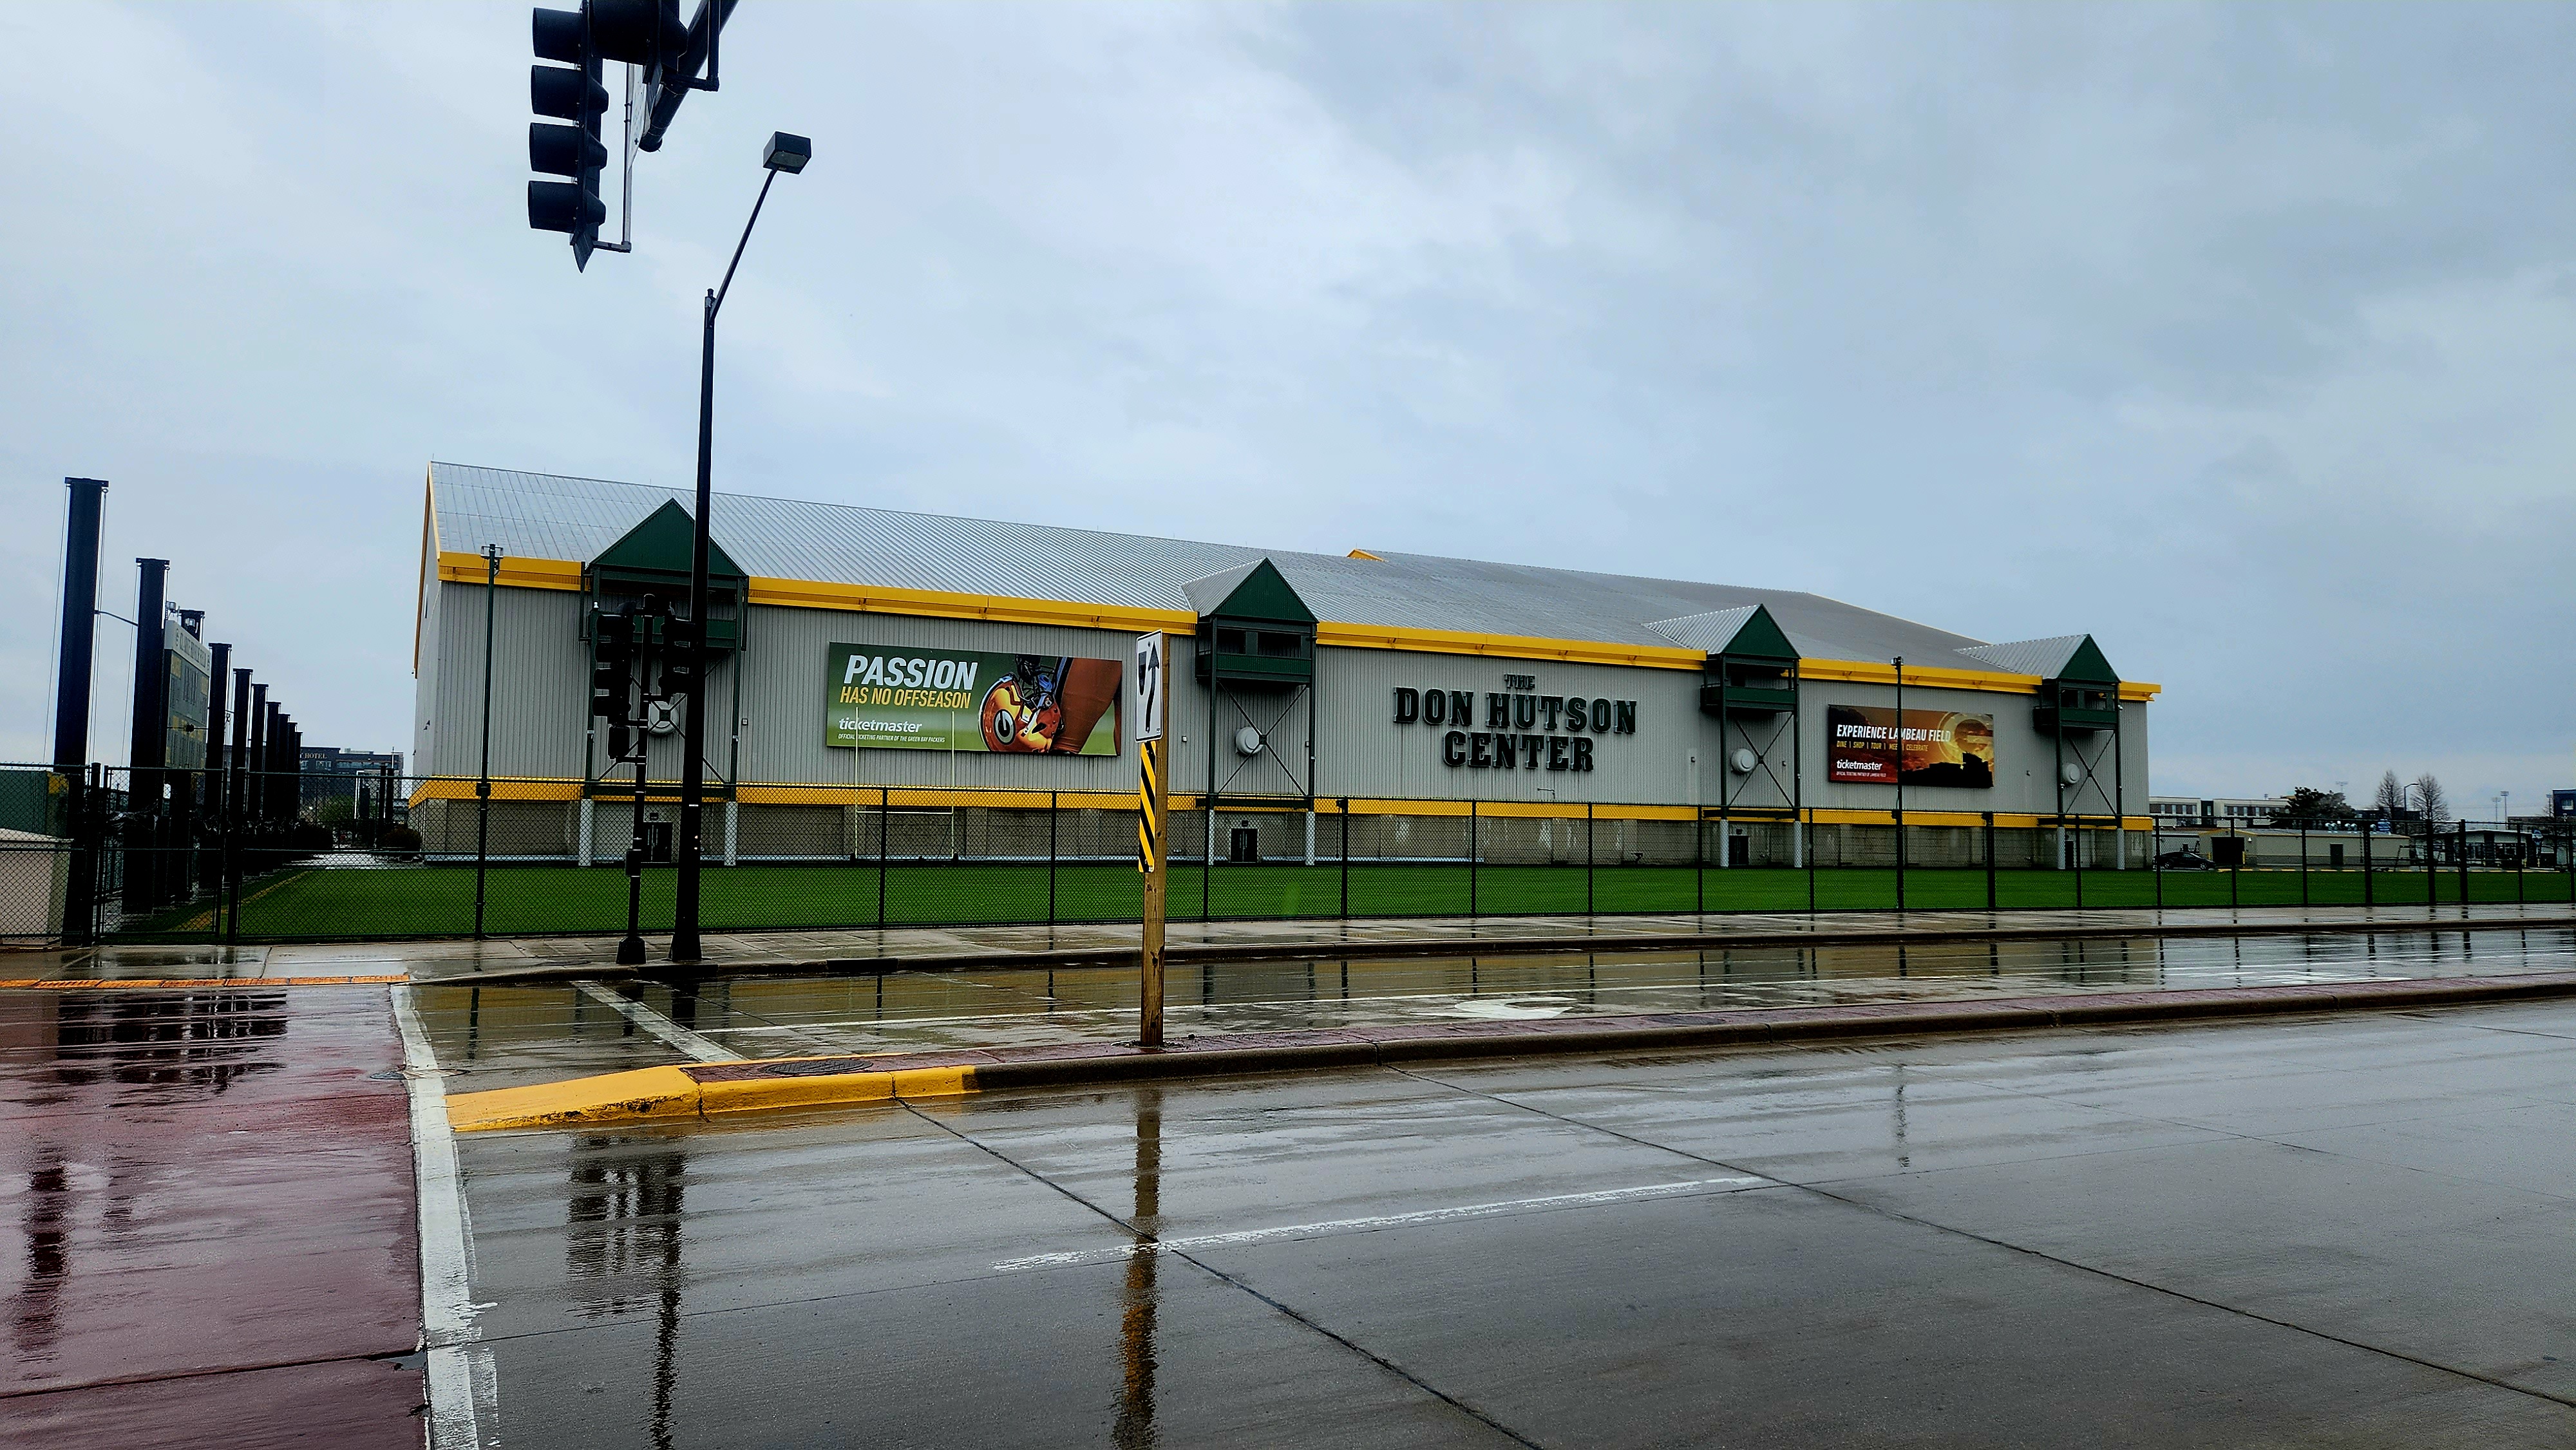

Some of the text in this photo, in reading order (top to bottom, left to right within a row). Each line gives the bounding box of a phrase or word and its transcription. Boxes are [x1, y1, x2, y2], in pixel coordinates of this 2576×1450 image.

[844, 654, 978, 690] PASSION
[1504, 673, 1535, 690] THE
[840, 686, 971, 708] HAS NO OFFSEASON
[1393, 686, 1637, 734] DON HUTSON
[839, 717, 923, 733] ticketmaster
[1836, 724, 1888, 740] EXPERIENCE
[1928, 730, 1951, 742] FIELD
[1443, 730, 1594, 772] CENTER
[1836, 759, 1882, 771] ticketmaster
